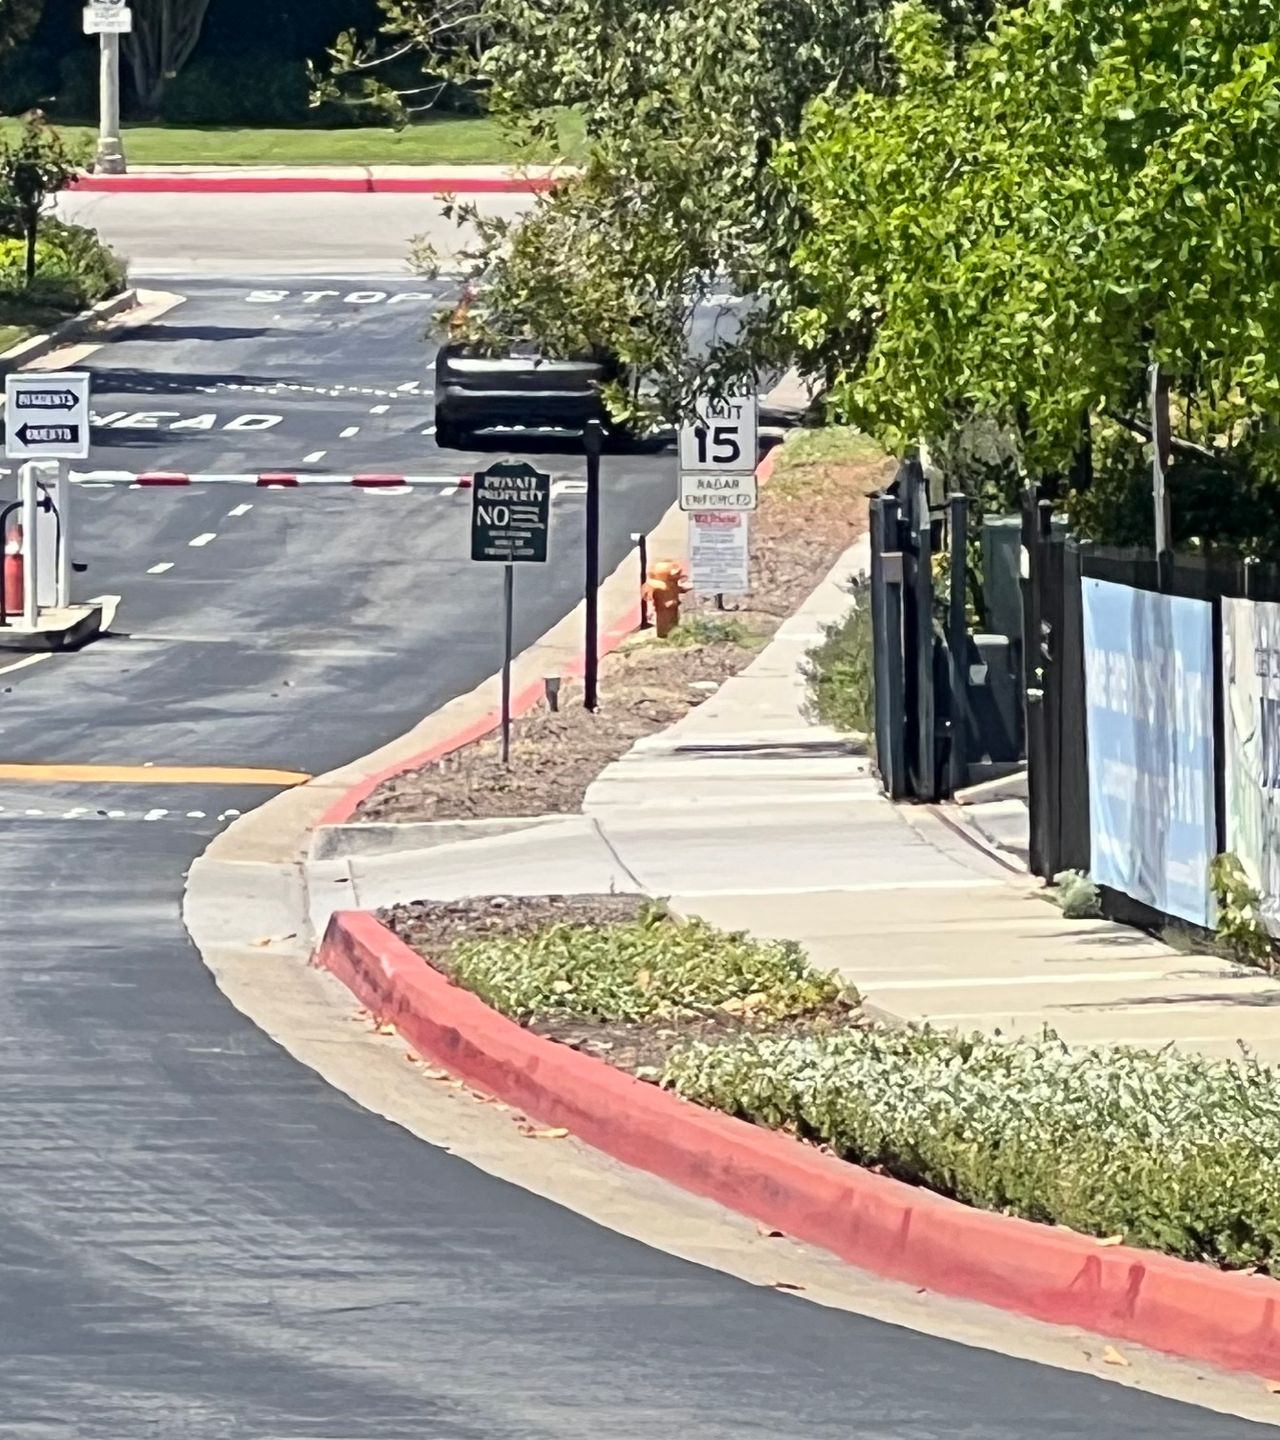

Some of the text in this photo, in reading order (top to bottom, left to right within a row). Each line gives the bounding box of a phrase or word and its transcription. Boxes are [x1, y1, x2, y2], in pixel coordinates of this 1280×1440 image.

[245, 289, 433, 304] STOP
[695, 426, 741, 464] 15
[697, 478, 740, 490] RADAR
[477, 505, 509, 527] NO
